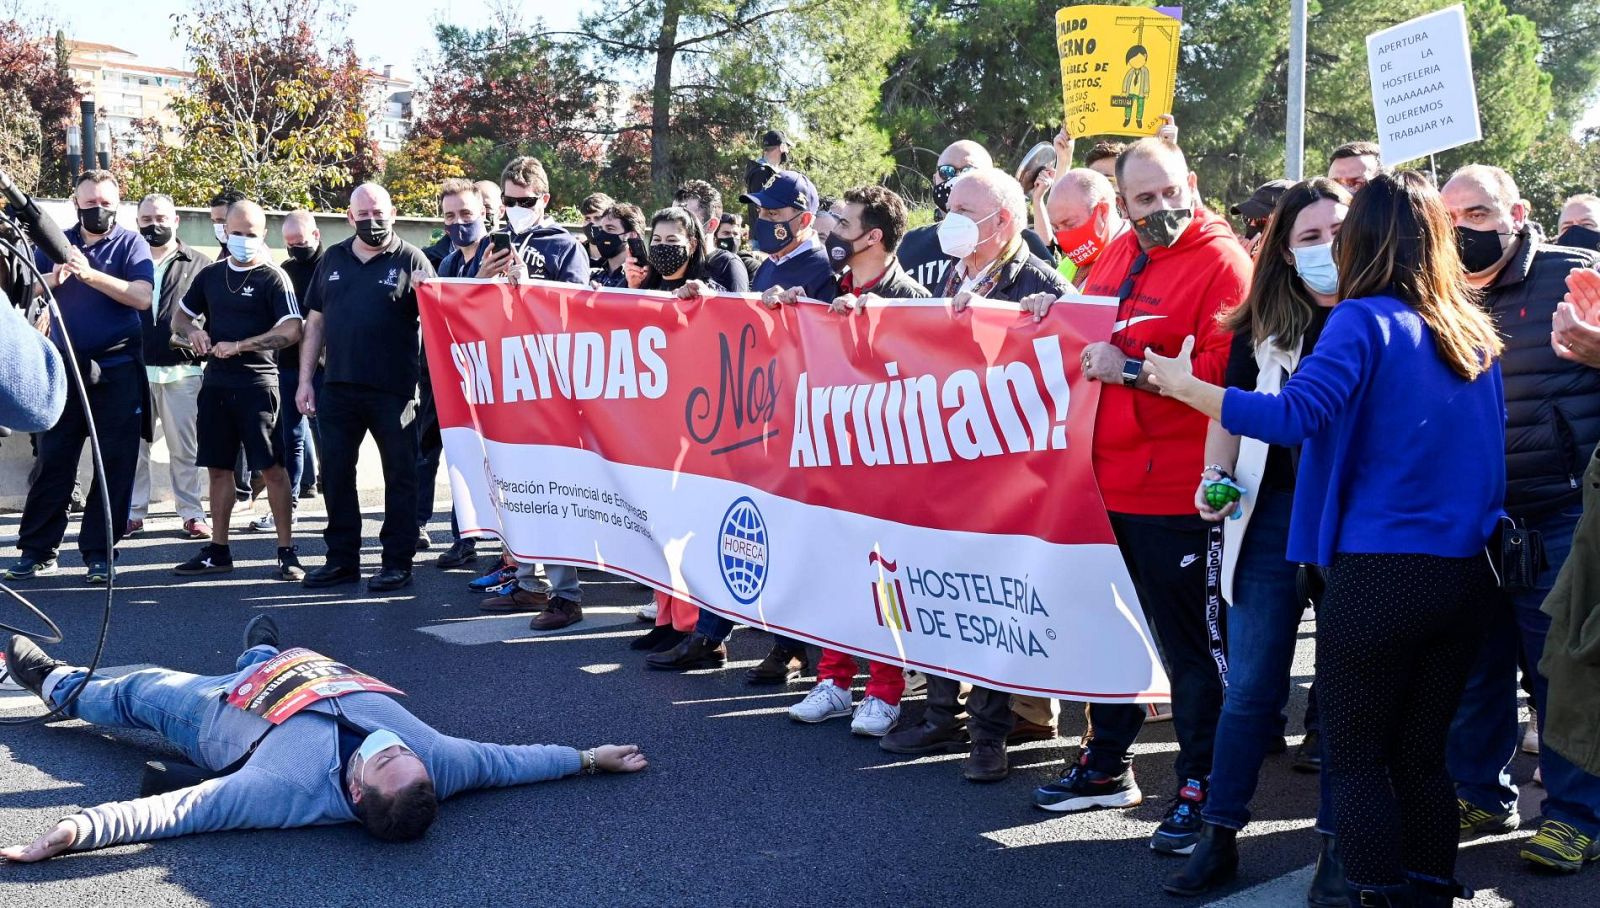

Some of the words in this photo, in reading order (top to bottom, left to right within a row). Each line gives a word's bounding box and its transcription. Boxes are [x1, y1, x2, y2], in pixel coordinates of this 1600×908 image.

[1378, 31, 1429, 56] APERTURA
[1094, 62, 1109, 73] DE
[1380, 62, 1393, 73] DE
[1421, 48, 1434, 59] LA
[1382, 64, 1441, 90] HOSTELERIA
[1386, 99, 1444, 125] QUEREMOS
[1389, 119, 1438, 142] TRABAJAR
[1440, 115, 1454, 127] YA
[501, 325, 668, 404] AYUDAS
[685, 323, 783, 445] Nos
[789, 334, 1071, 468] Arruinan!
[549, 481, 600, 502] Provincial
[601, 489, 614, 505] de
[562, 504, 569, 518] y
[570, 503, 609, 523] Turismo
[610, 512, 623, 528] de
[724, 536, 764, 562] HORECA
[1210, 540, 1221, 551] IT
[1209, 550, 1220, 567] DO
[1207, 566, 1218, 587] JUST
[906, 566, 1050, 618] HOSTELERÍA
[1208, 594, 1218, 606] IT
[1207, 604, 1218, 620] DO
[916, 607, 952, 639] DE
[958, 613, 1049, 659] ESPAÑA
[1208, 619, 1220, 641] JUST
